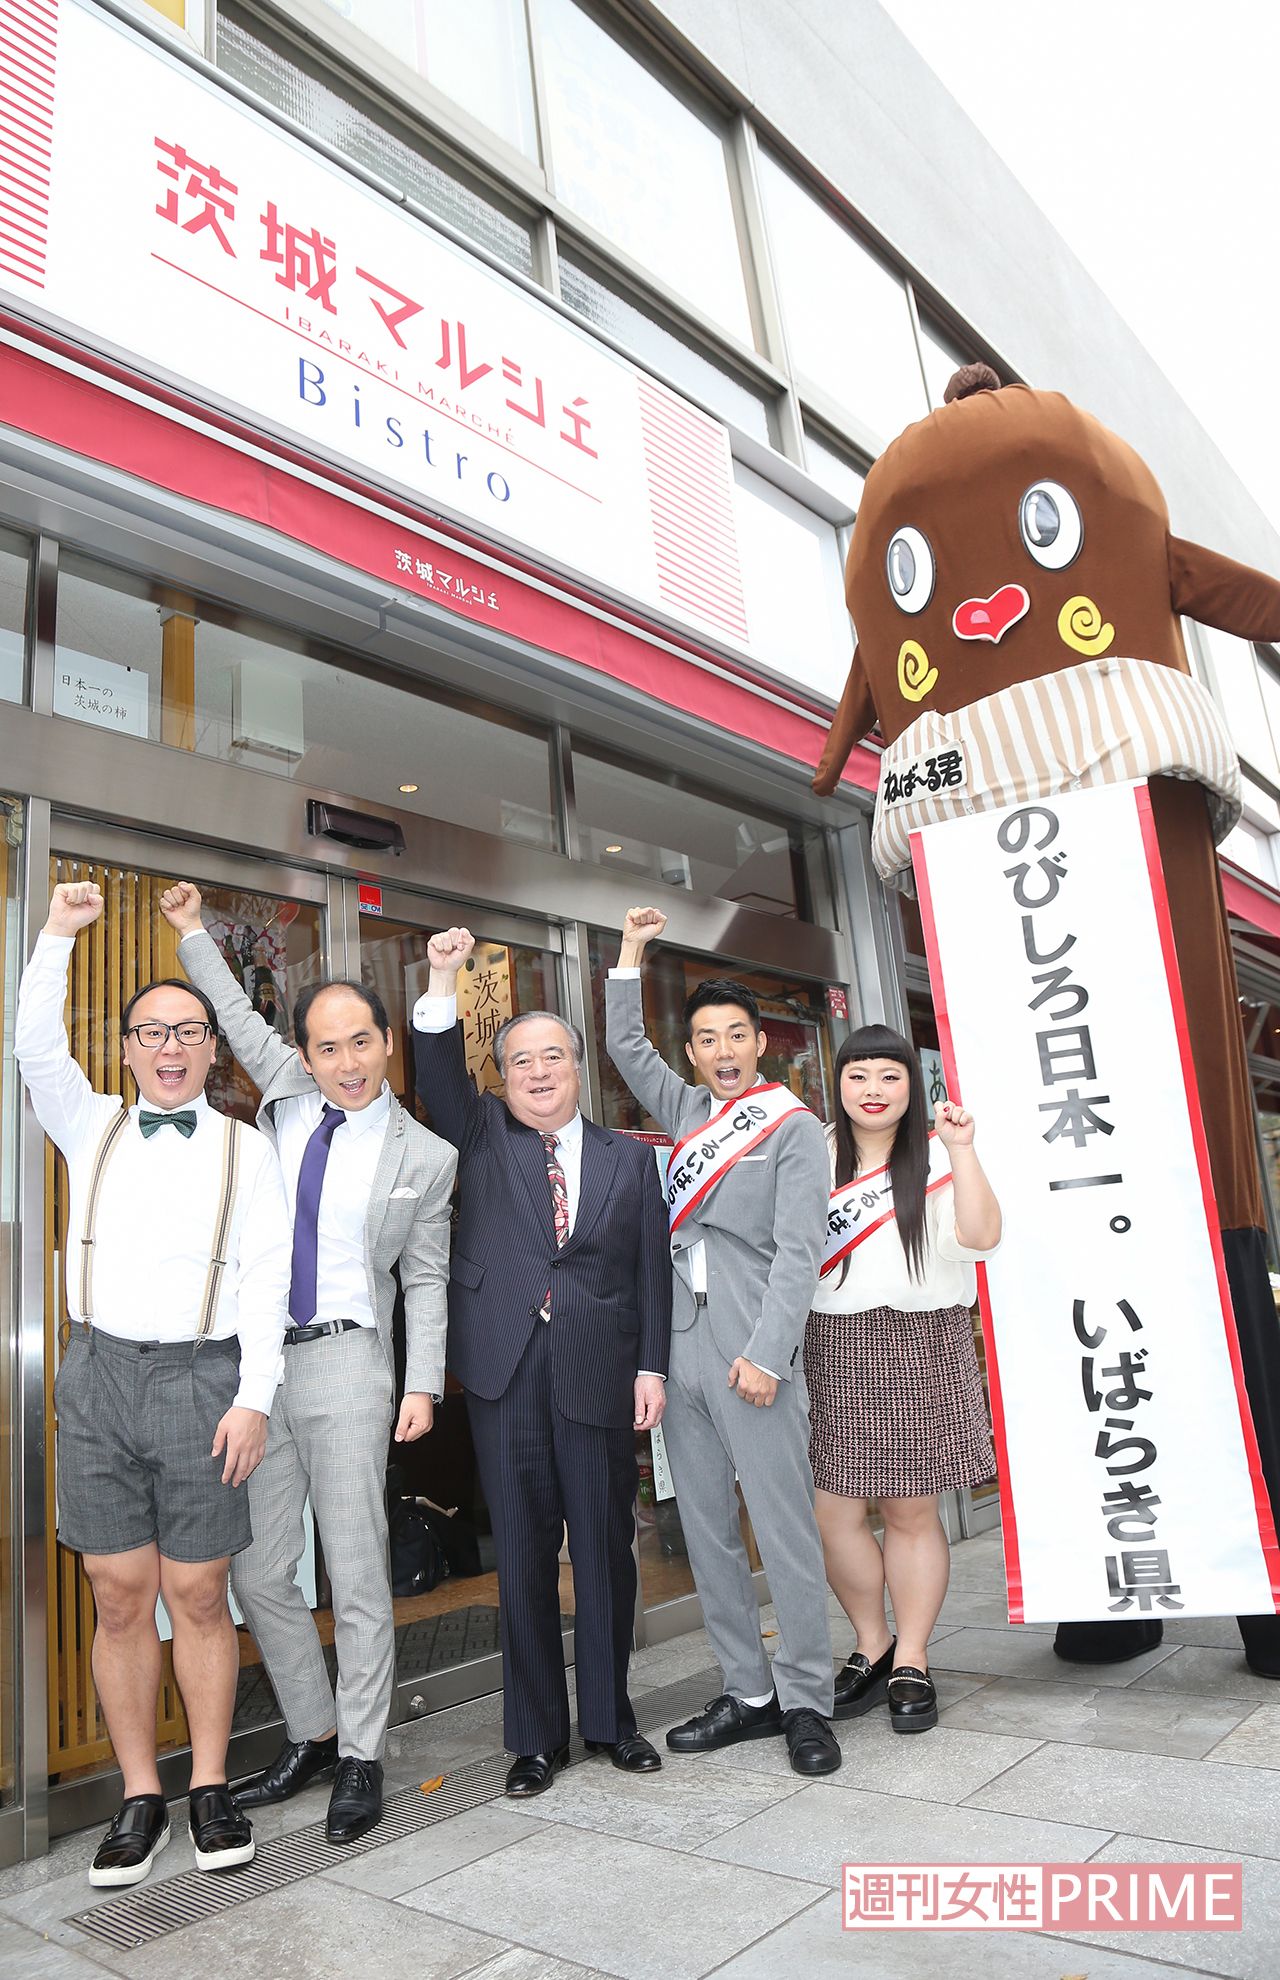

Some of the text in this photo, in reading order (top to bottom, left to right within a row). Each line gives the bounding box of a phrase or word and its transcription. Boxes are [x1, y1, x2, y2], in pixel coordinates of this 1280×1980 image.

[154, 136, 598, 459] 茨城マルシェ
[285, 307, 515, 446] IBARAKI MARCHÉ
[299, 357, 511, 502] Bistro
[394, 549, 500, 610] 茨城マルシェ
[62, 674, 113, 697] 日本一の
[74, 694, 127, 720] 茨城の柿
[472, 970, 503, 1098] 茨城へ
[668, 1105, 768, 1214] のびーるいばら
